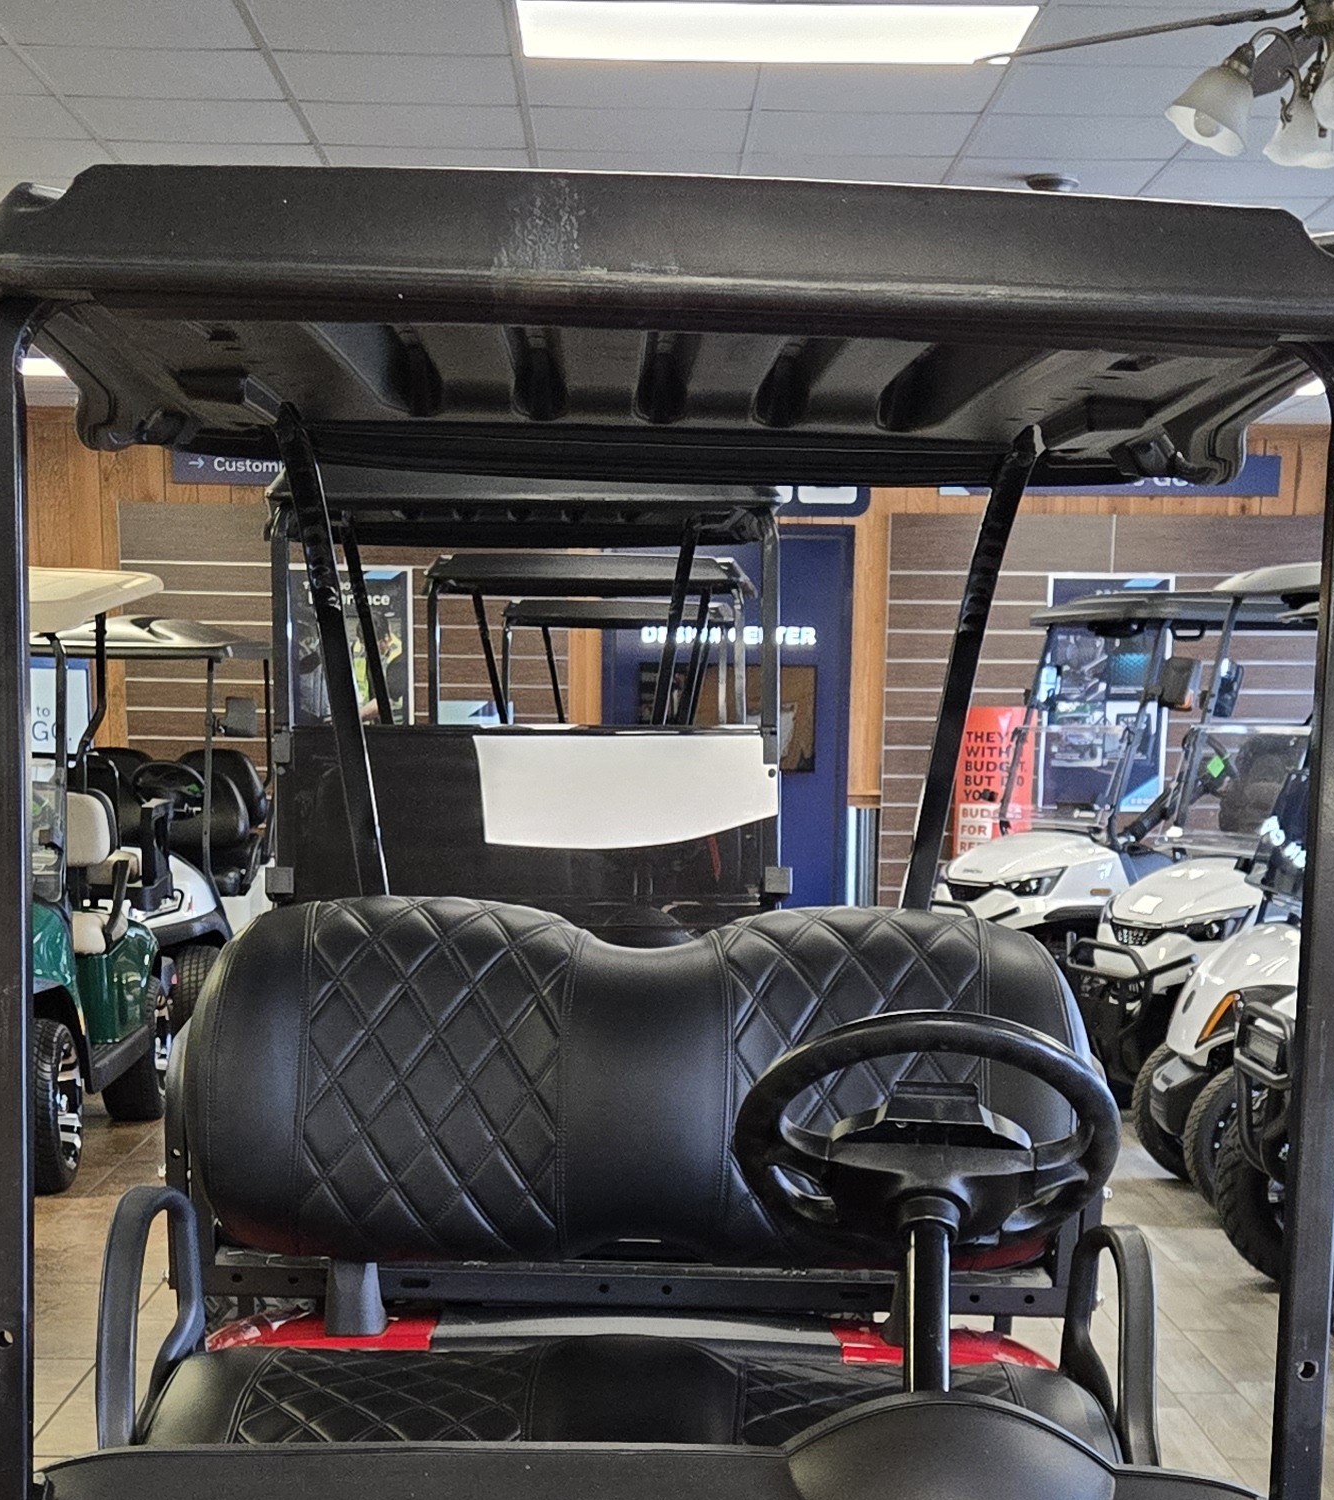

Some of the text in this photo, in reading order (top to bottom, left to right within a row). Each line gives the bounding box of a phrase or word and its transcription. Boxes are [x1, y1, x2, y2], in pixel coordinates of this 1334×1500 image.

[214, 457, 284, 473] Customi
[36, 706, 51, 718] to
[32, 721, 72, 741] G.
[966, 731, 1010, 744] THEY
[966, 746, 1012, 758] WITH
[965, 761, 1027, 773] BUDGT.
[965, 776, 995, 787] BUT
[964, 789, 989, 801] YO
[961, 825, 987, 836] FOR
